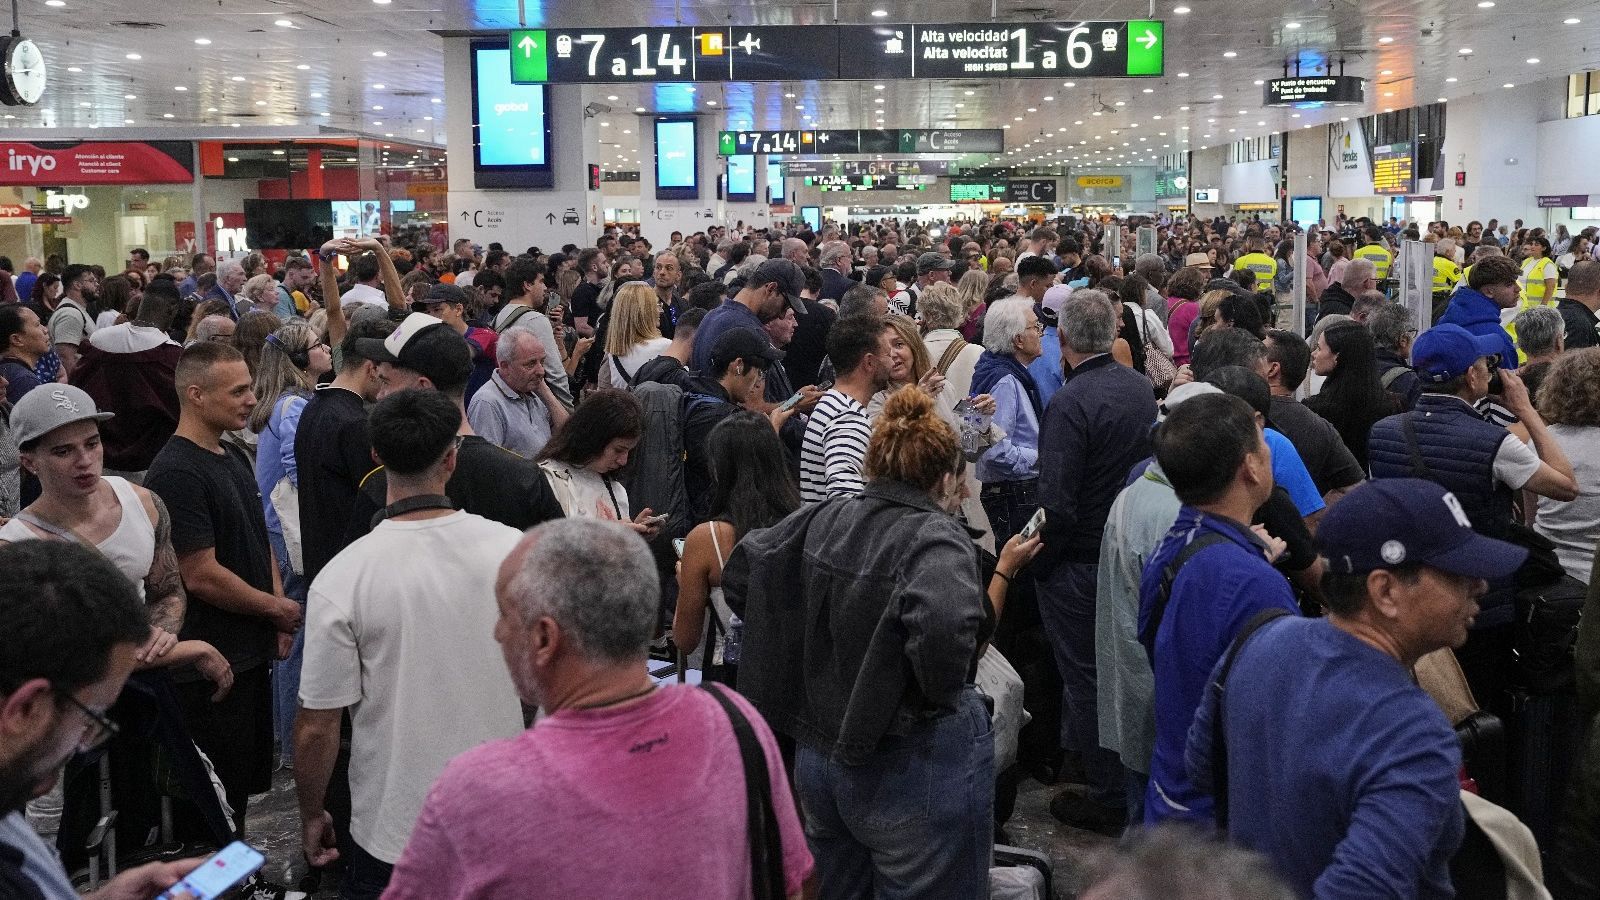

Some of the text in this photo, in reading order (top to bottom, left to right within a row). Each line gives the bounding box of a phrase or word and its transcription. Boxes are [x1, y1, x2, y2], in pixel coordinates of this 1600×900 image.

[921, 30, 1008, 42] Alta velocidad
[581, 34, 686, 76] 7 a 14
[924, 46, 1008, 59] Alta velocitat
[1010, 27, 1093, 69] 1 a 6
[964, 64, 984, 72] HIGH
[750, 134, 762, 152] 7
[772, 132, 796, 152] 14
[930, 132, 940, 150] C
[8, 149, 56, 176] iryo
[1032, 182, 1040, 200] C
[0, 206, 20, 216] ryo
[46, 190, 90, 214] iryo
[474, 210, 482, 228] C
[51, 390, 80, 412] Sox
